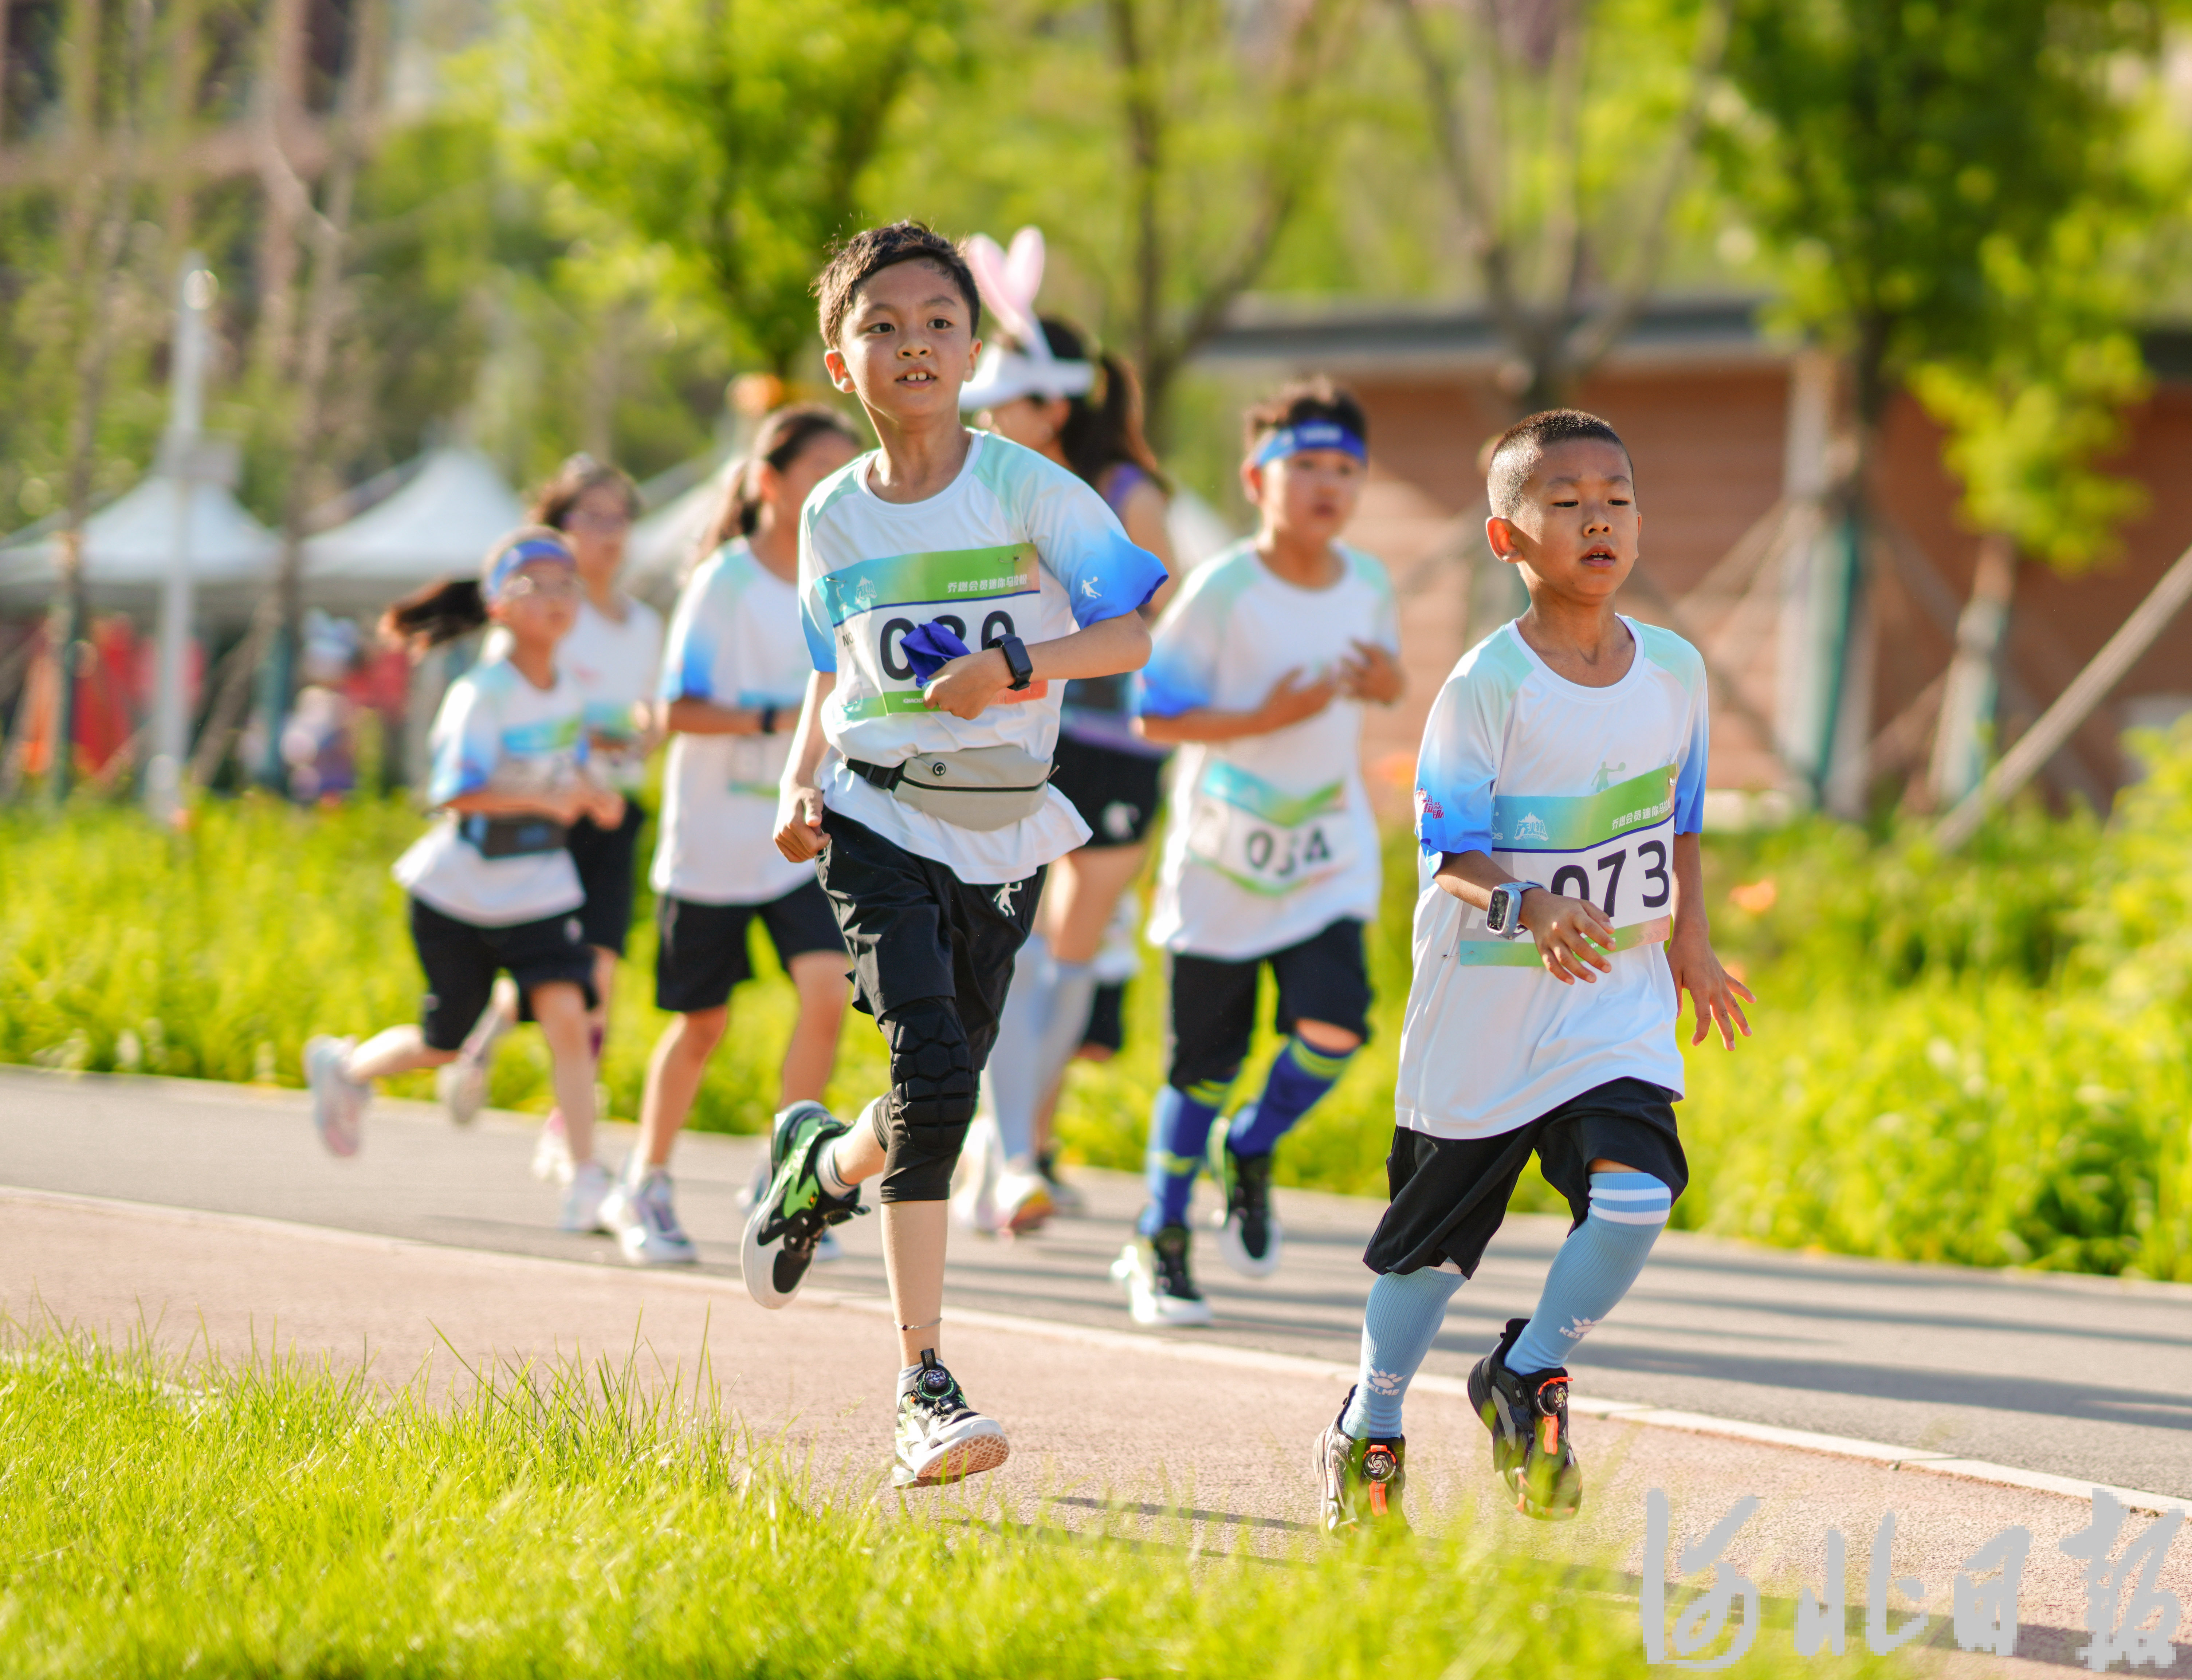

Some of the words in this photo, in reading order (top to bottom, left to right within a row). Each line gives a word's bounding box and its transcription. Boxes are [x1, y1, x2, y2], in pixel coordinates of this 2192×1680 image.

[1611, 796, 1671, 830] 乔燃会员迷你马拉松
[1551, 839, 1670, 918] 073
